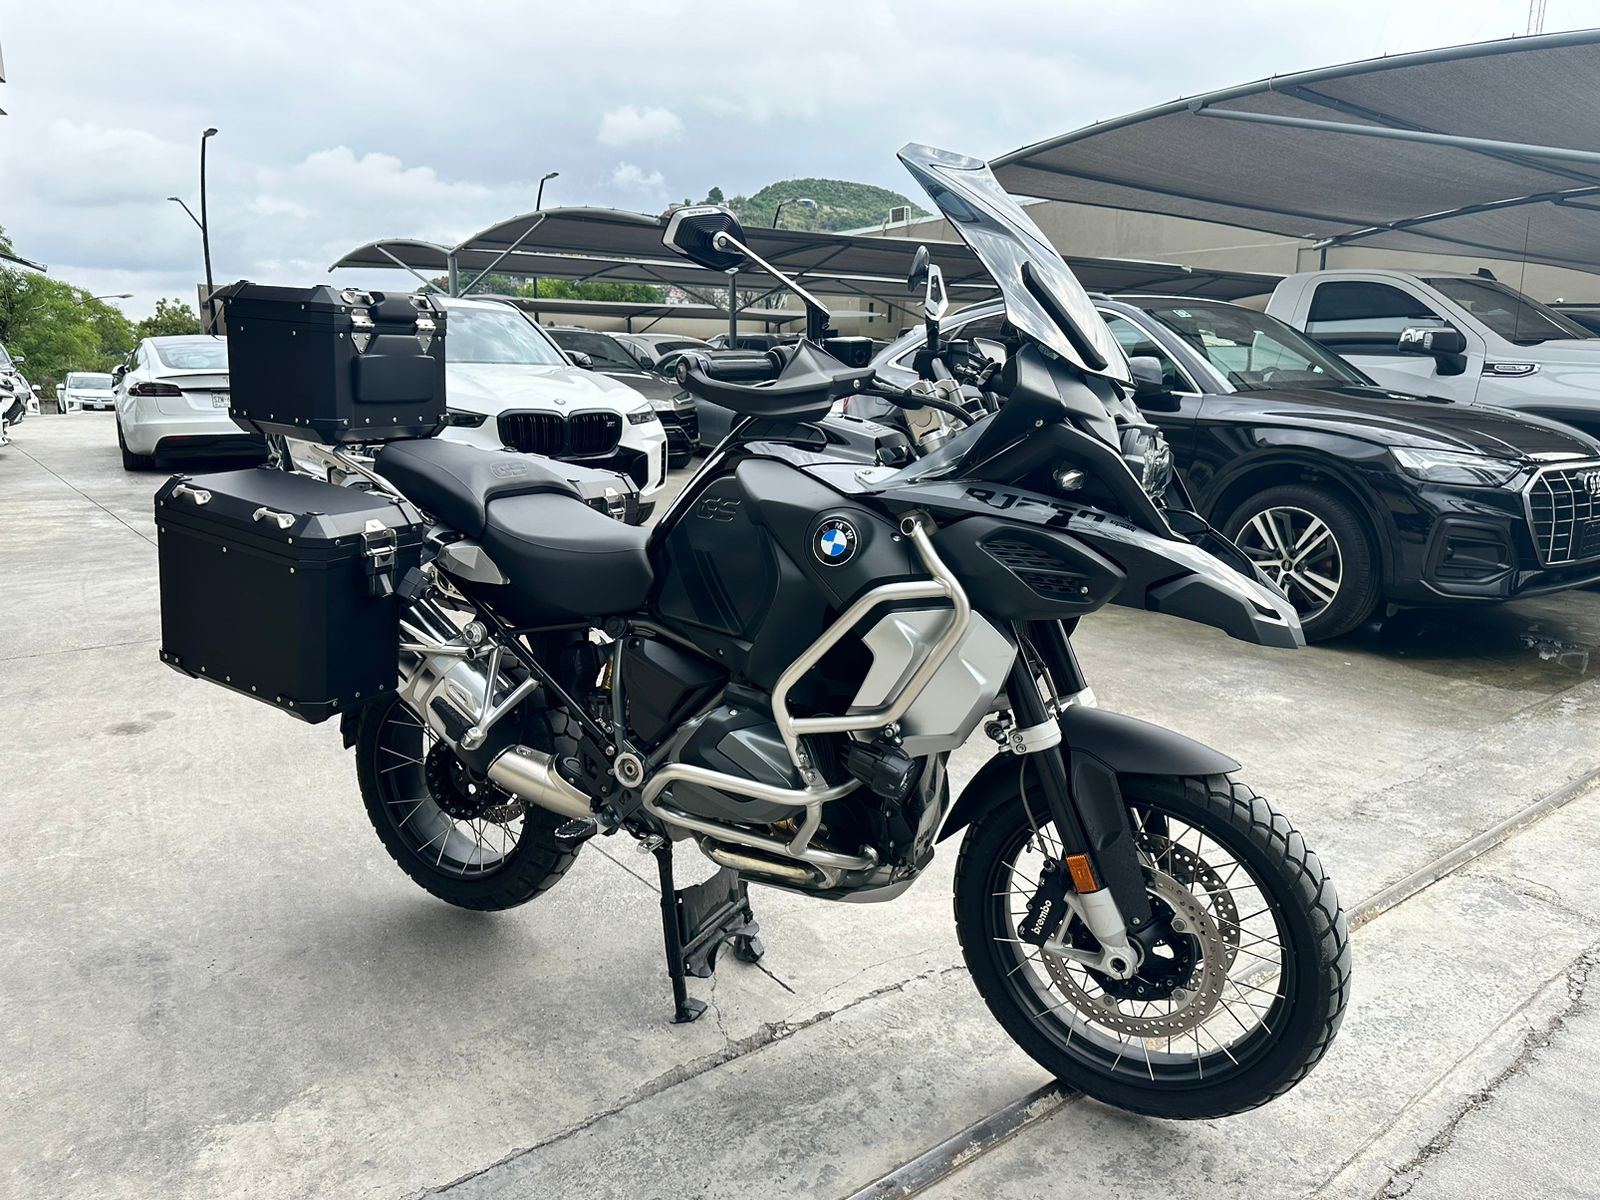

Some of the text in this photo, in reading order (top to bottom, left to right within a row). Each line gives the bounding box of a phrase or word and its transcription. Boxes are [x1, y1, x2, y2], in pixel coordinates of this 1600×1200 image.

[697, 497, 741, 522] GS
[820, 522, 854, 540] BMW
[1030, 899, 1053, 935] brembo
